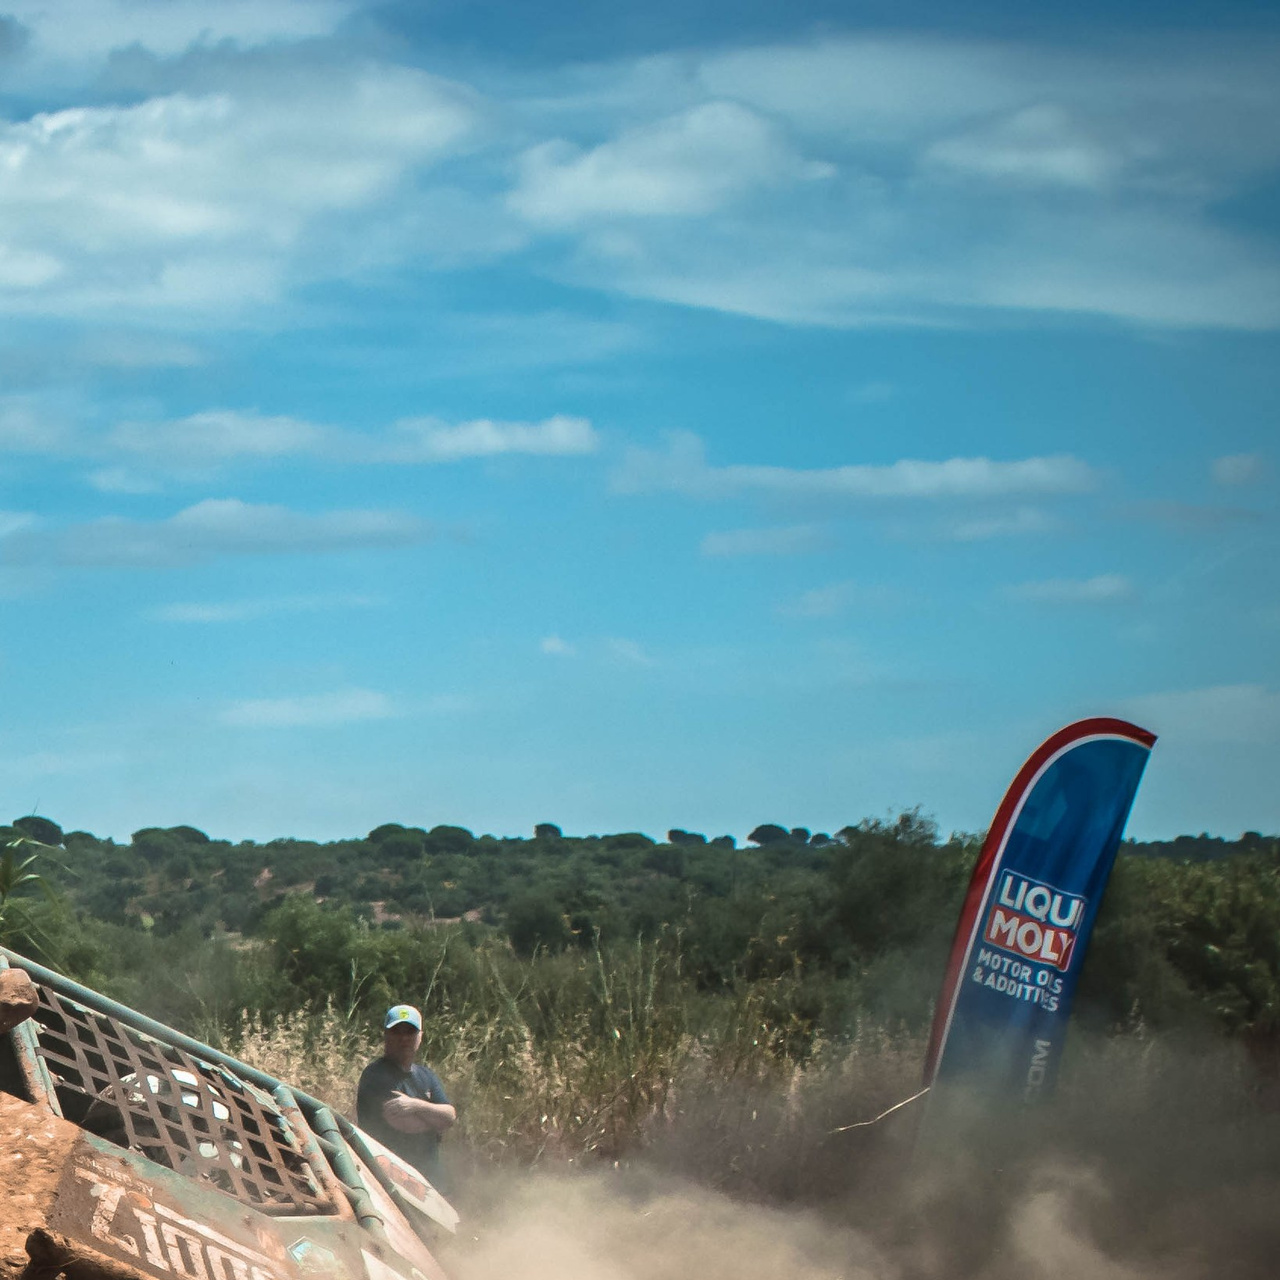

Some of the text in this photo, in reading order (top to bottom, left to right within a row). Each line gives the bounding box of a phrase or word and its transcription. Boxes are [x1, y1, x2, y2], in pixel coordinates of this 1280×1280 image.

[999, 875, 1084, 930] LIQUI
[989, 909, 1073, 965] MOLY
[978, 947, 1032, 983] MOTOR
